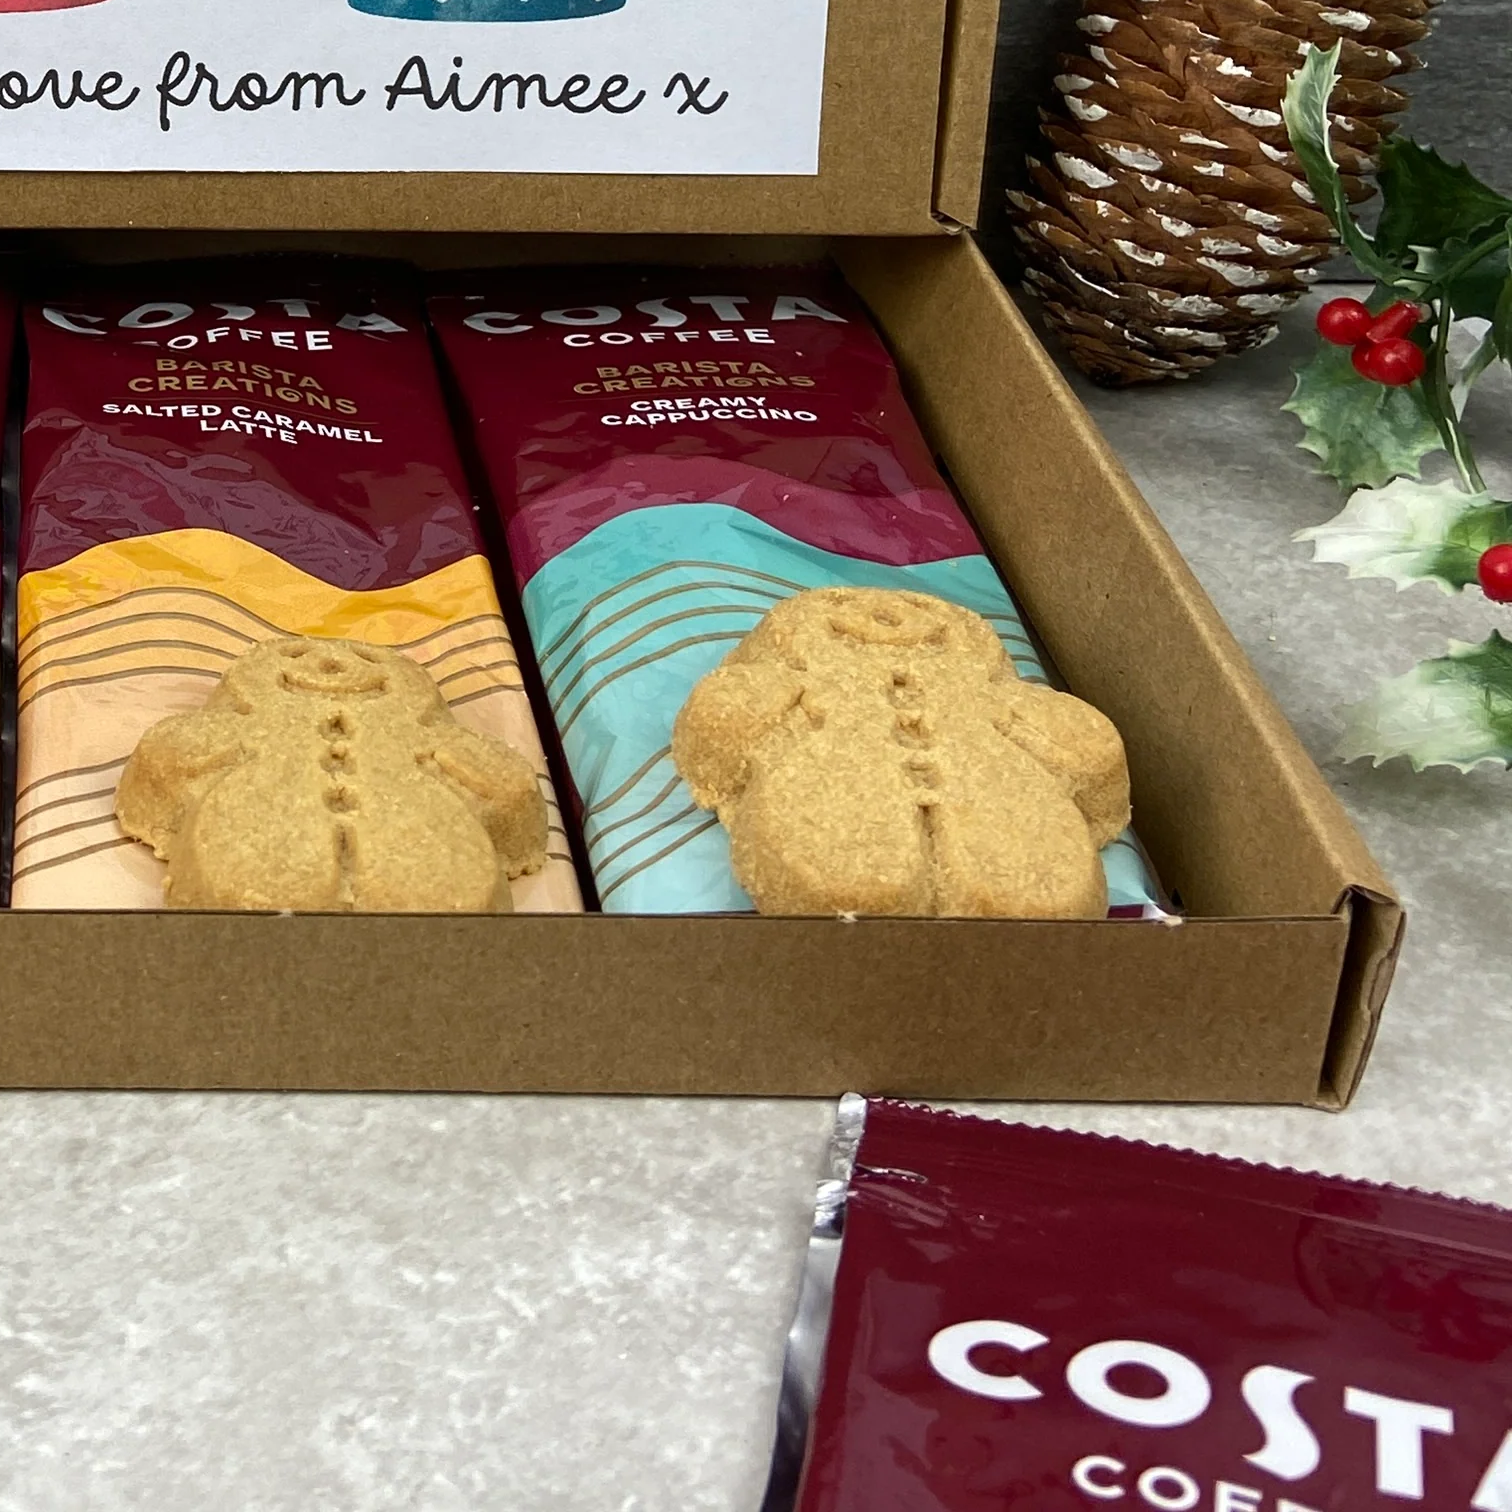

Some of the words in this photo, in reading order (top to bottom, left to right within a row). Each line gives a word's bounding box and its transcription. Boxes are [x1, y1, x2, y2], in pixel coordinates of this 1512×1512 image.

[157, 50, 366, 132] from
[383, 56, 646, 114] Aimee
[662, 72, 729, 114] x
[463, 296, 849, 334] COSTA
[132, 327, 333, 351] OFFEE
[563, 328, 776, 347] COFFEE
[155, 359, 324, 391] BARISTA
[596, 361, 776, 378] BARISTA
[127, 375, 359, 415] CREATIONS
[573, 376, 816, 395] CREATIONS
[630, 396, 767, 411] CREAMY
[102, 403, 222, 418] SALTED
[231, 406, 383, 444] CARAMEL
[600, 408, 818, 426] CAPPUCCINO
[200, 419, 298, 444] LATTE
[926, 1318, 1512, 1512] COST
